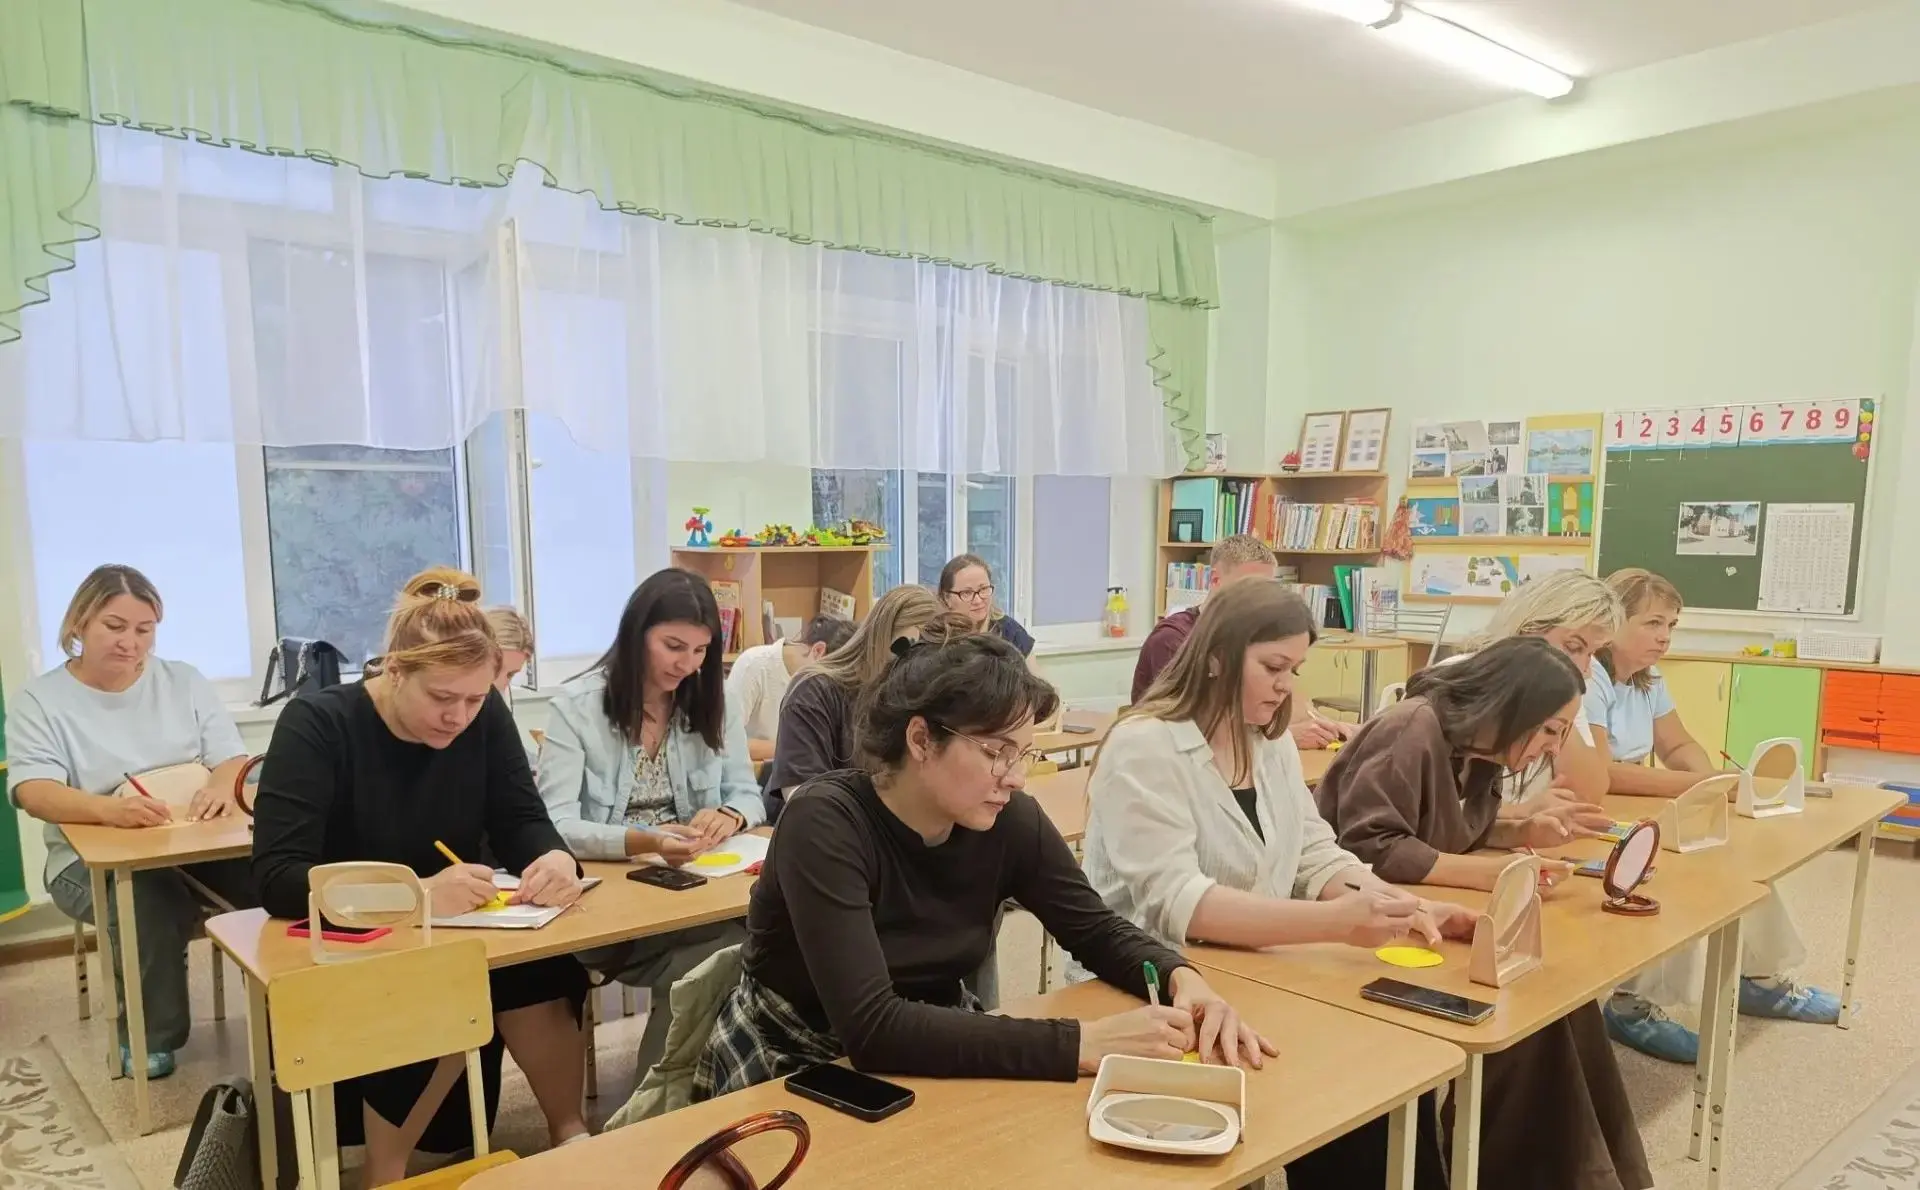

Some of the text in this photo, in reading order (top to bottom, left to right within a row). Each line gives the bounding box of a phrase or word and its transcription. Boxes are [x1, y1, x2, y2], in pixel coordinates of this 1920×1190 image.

[1615, 407, 1850, 438] 1 2 3 4 5 6 7 8 9
